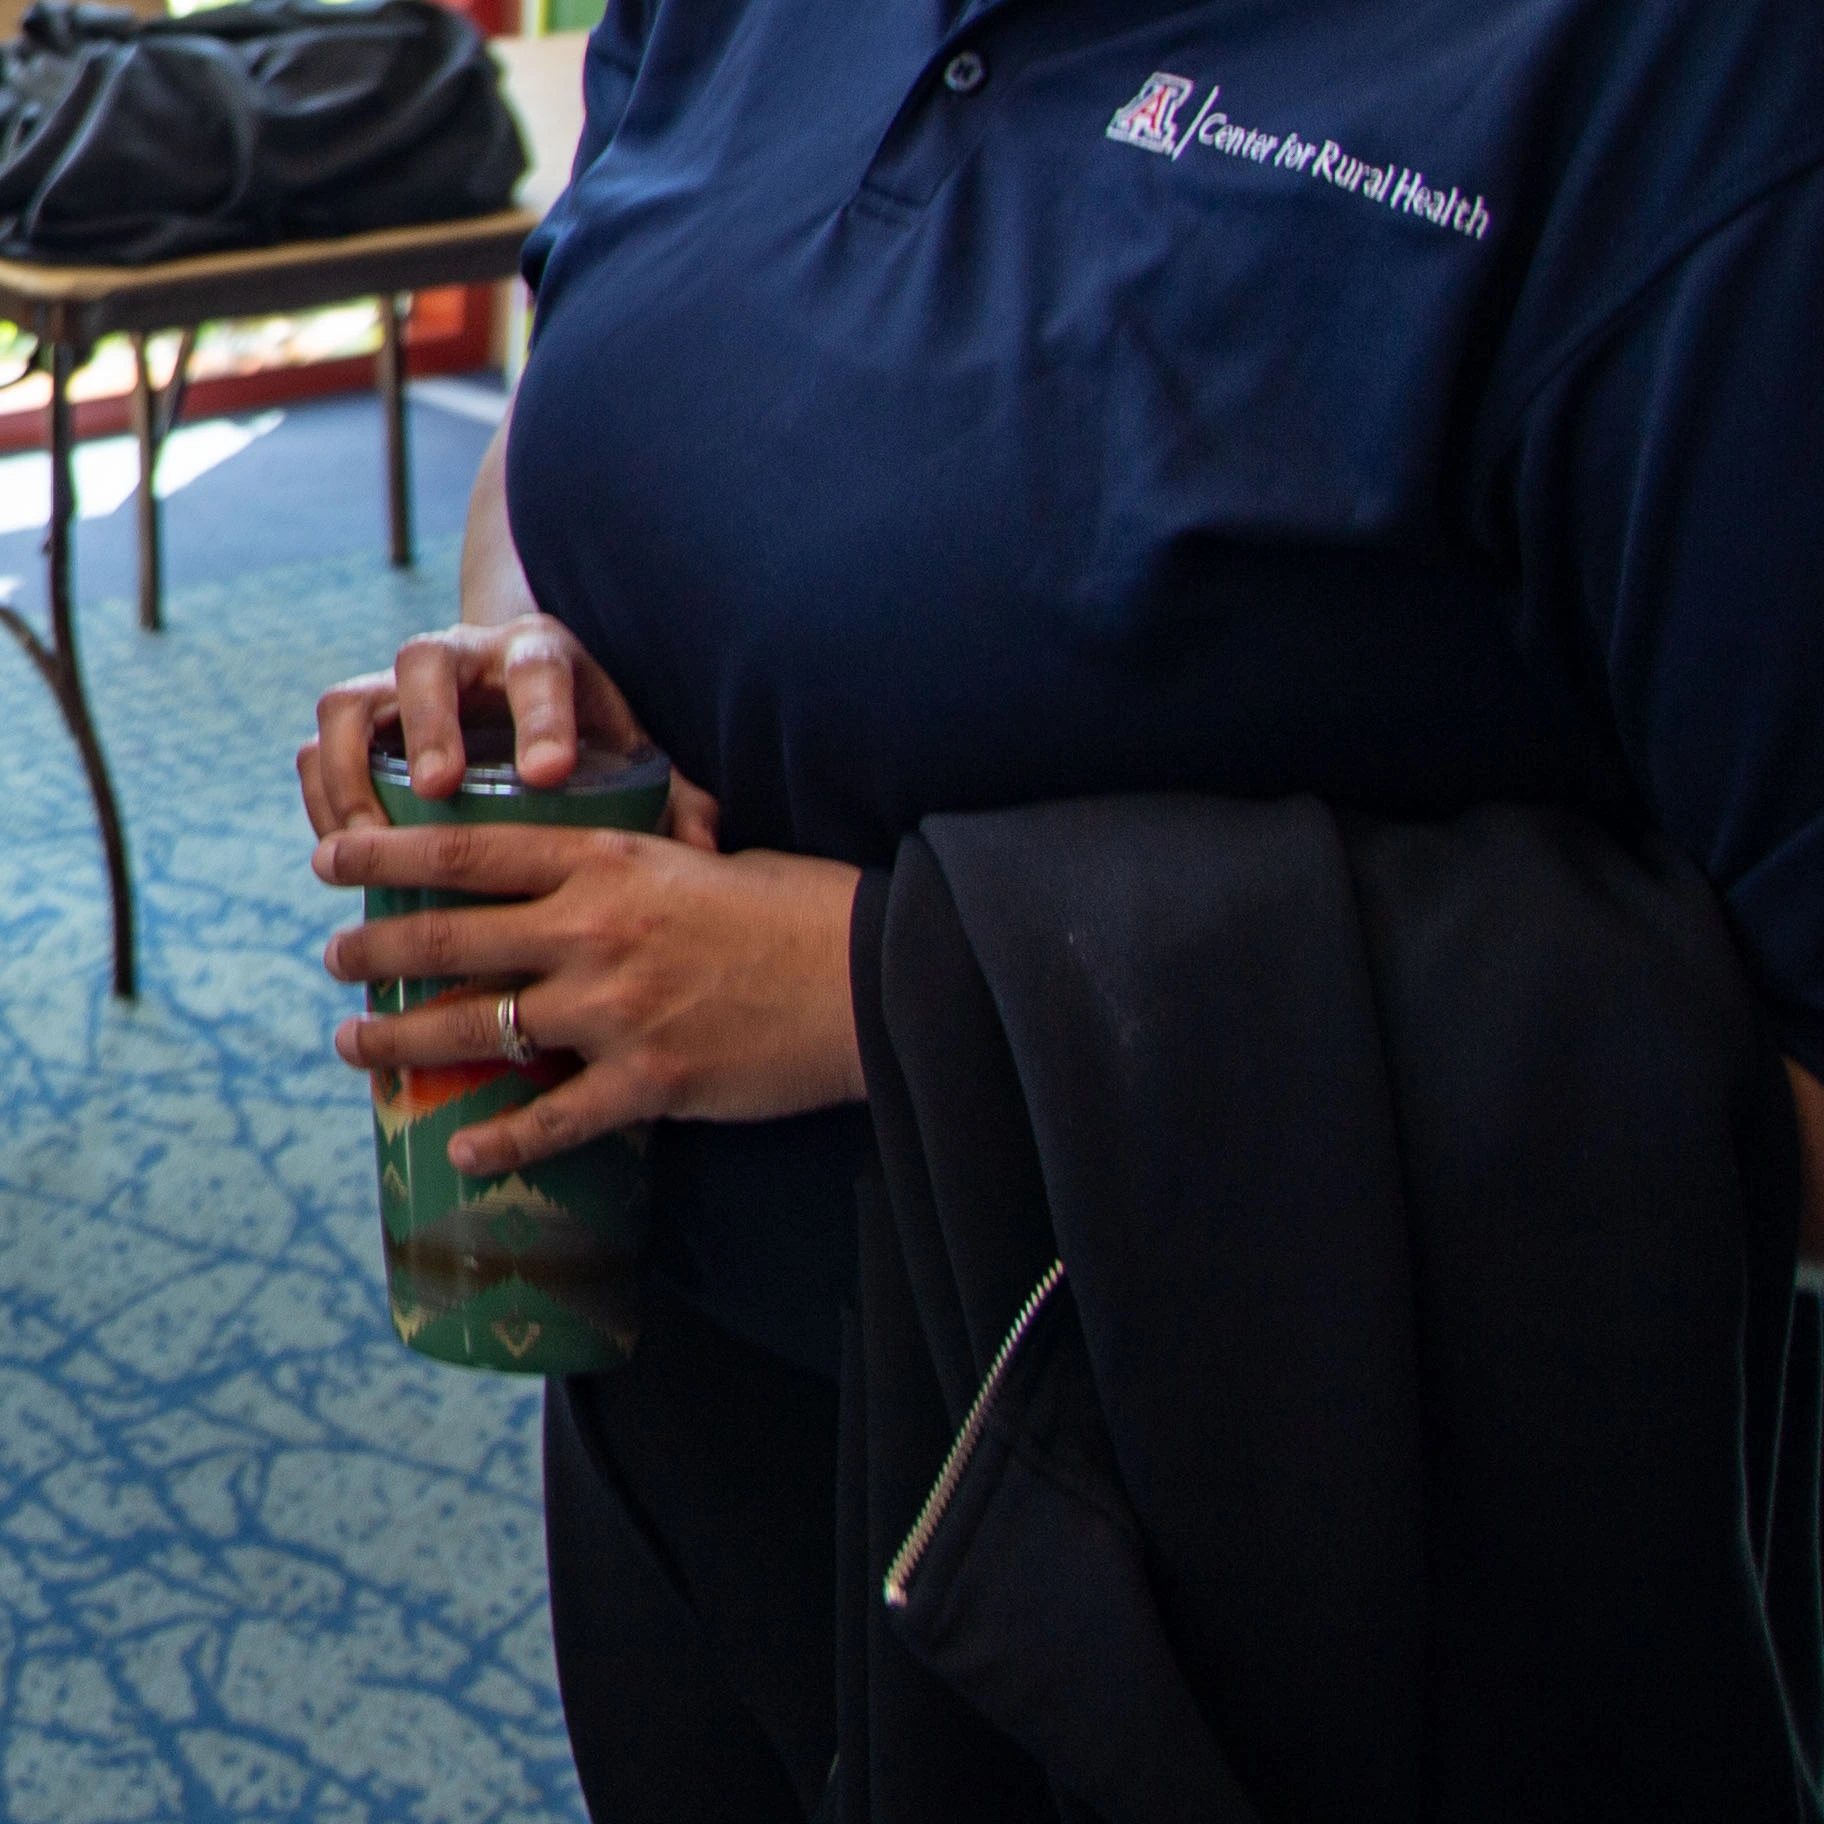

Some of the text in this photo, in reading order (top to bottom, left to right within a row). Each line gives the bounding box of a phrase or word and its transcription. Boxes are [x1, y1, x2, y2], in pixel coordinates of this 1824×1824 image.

[1198, 111, 1279, 164] Center
[1273, 132, 1318, 172] for
[1311, 139, 1396, 204] Rural
[1389, 167, 1493, 241] Health
